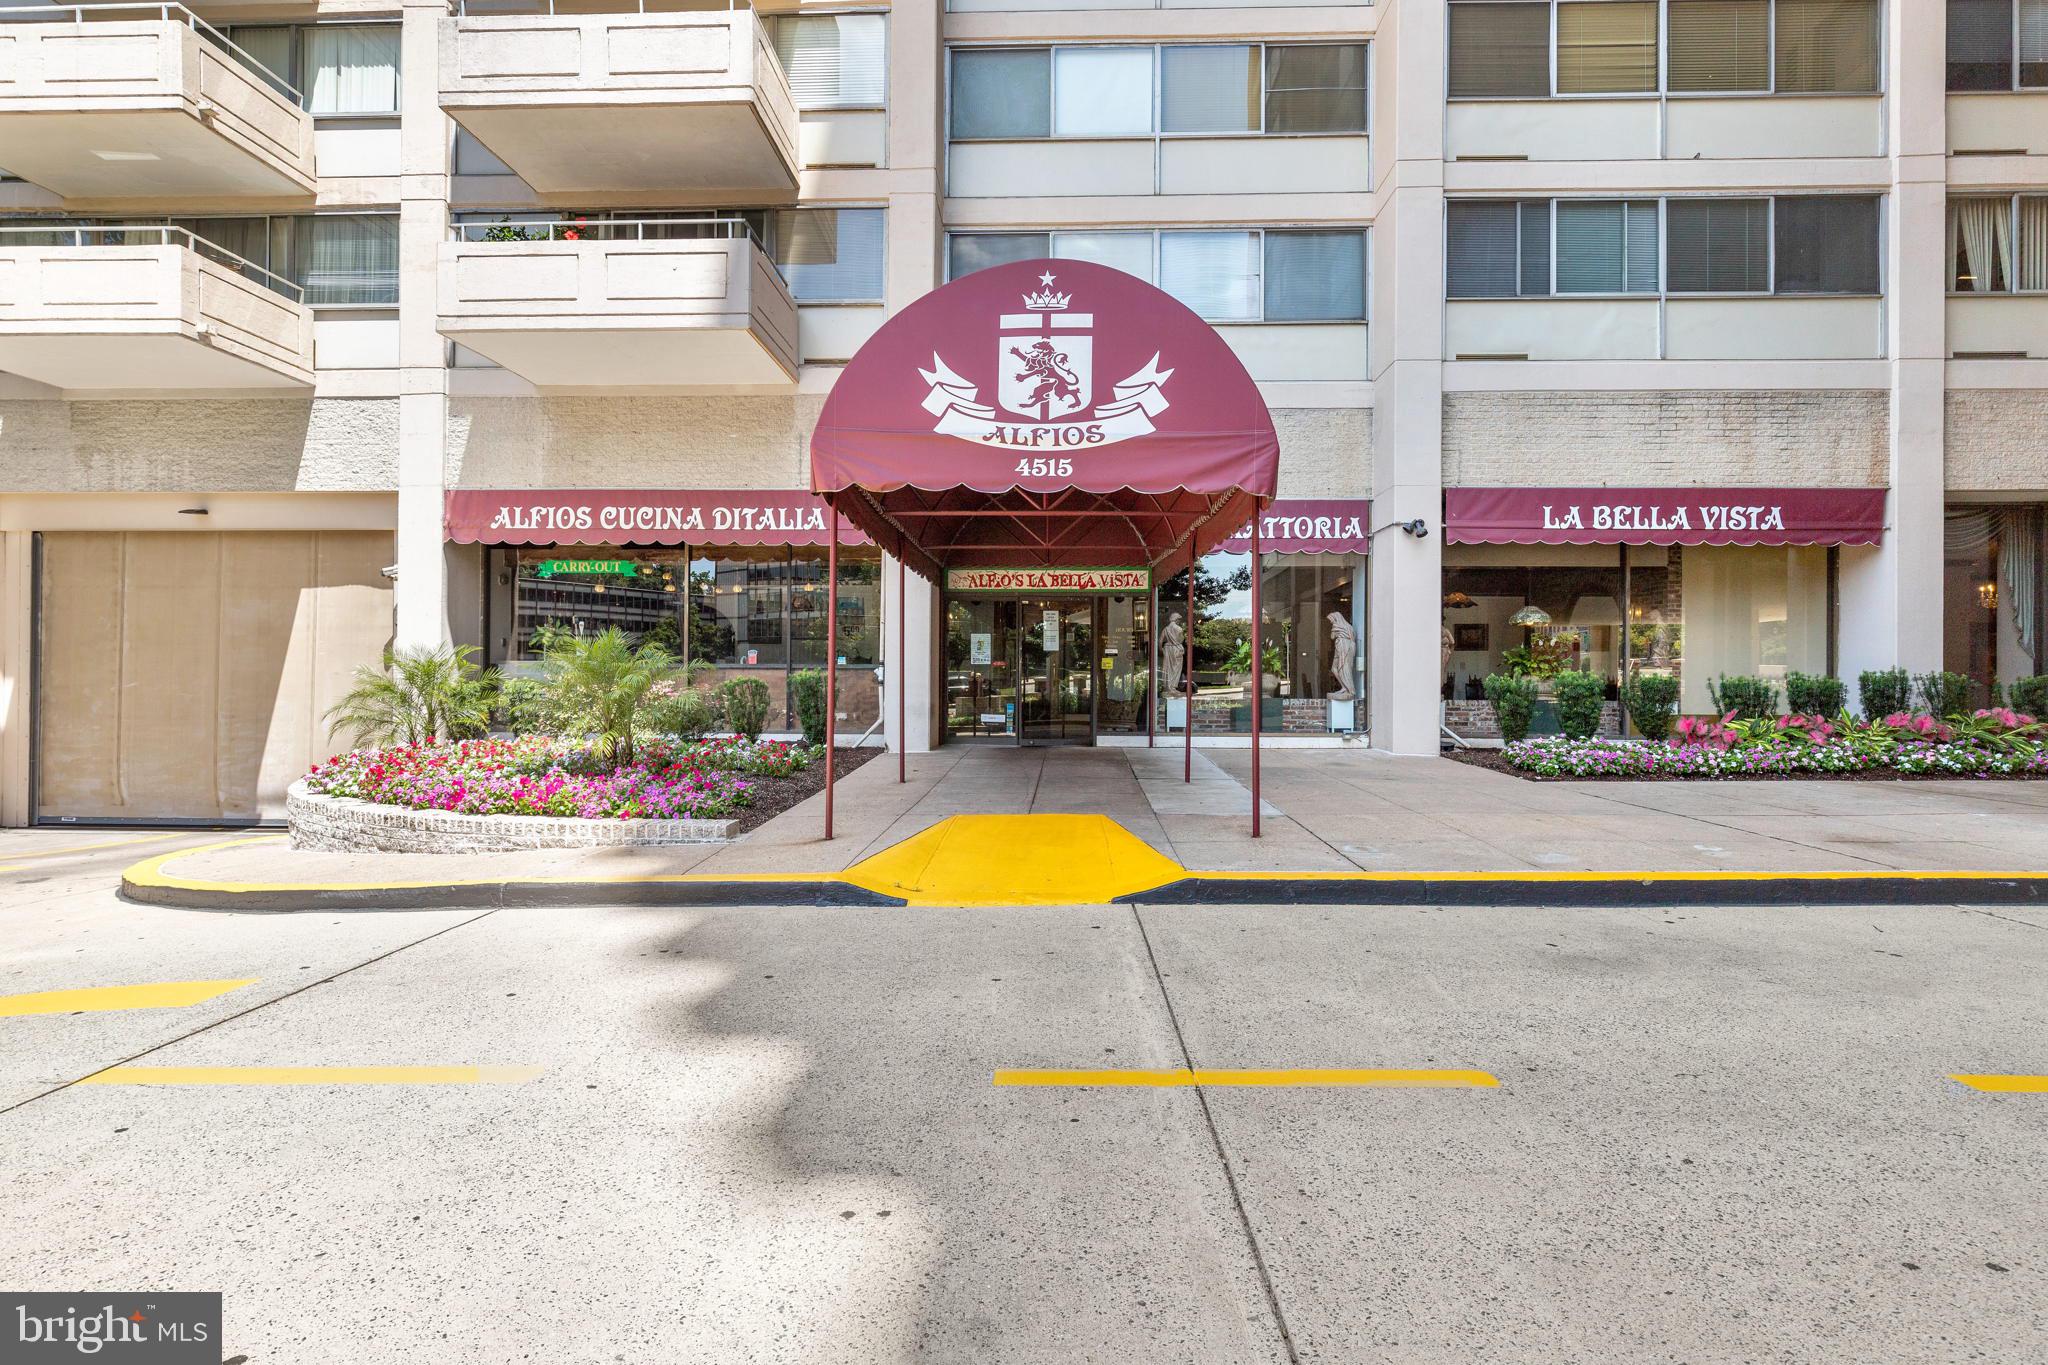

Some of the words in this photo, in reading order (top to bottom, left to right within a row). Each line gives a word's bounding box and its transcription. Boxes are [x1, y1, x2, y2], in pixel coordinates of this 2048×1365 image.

[982, 425, 1105, 446] ALFIOS
[1014, 458, 1073, 477] 4515
[490, 506, 593, 530] ALFIOS
[599, 506, 705, 530] CUCINA
[712, 507, 827, 530] DITALIA
[1542, 505, 1585, 530] LA
[1592, 506, 1692, 530] BELLA
[1699, 506, 1786, 530] VISTA
[553, 561, 621, 573] CARRY-OUT
[1026, 573, 1048, 588] LA
[1048, 572, 1096, 589] BELLA
